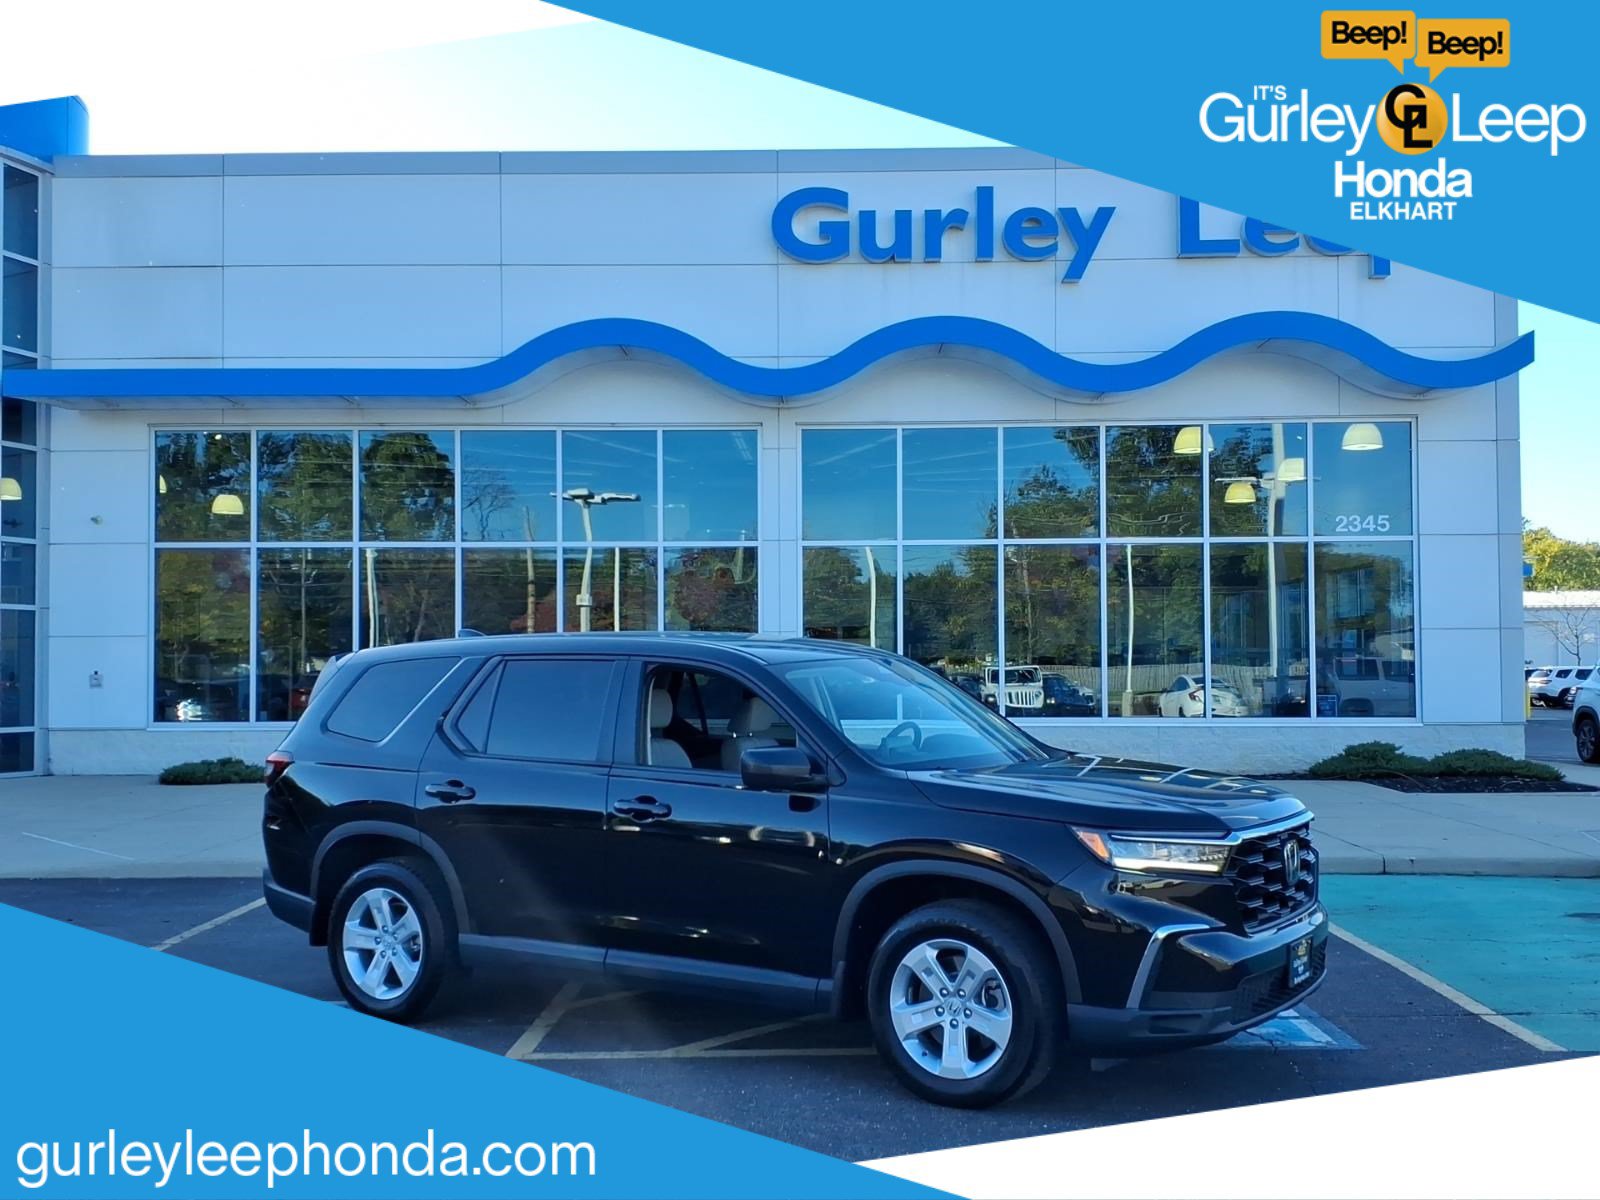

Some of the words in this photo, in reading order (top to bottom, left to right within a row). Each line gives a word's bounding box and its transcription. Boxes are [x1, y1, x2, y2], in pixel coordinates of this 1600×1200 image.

[771, 186, 1116, 284] Gurley
[1177, 195, 1391, 279] Le
[1335, 514, 1391, 532] 2345
